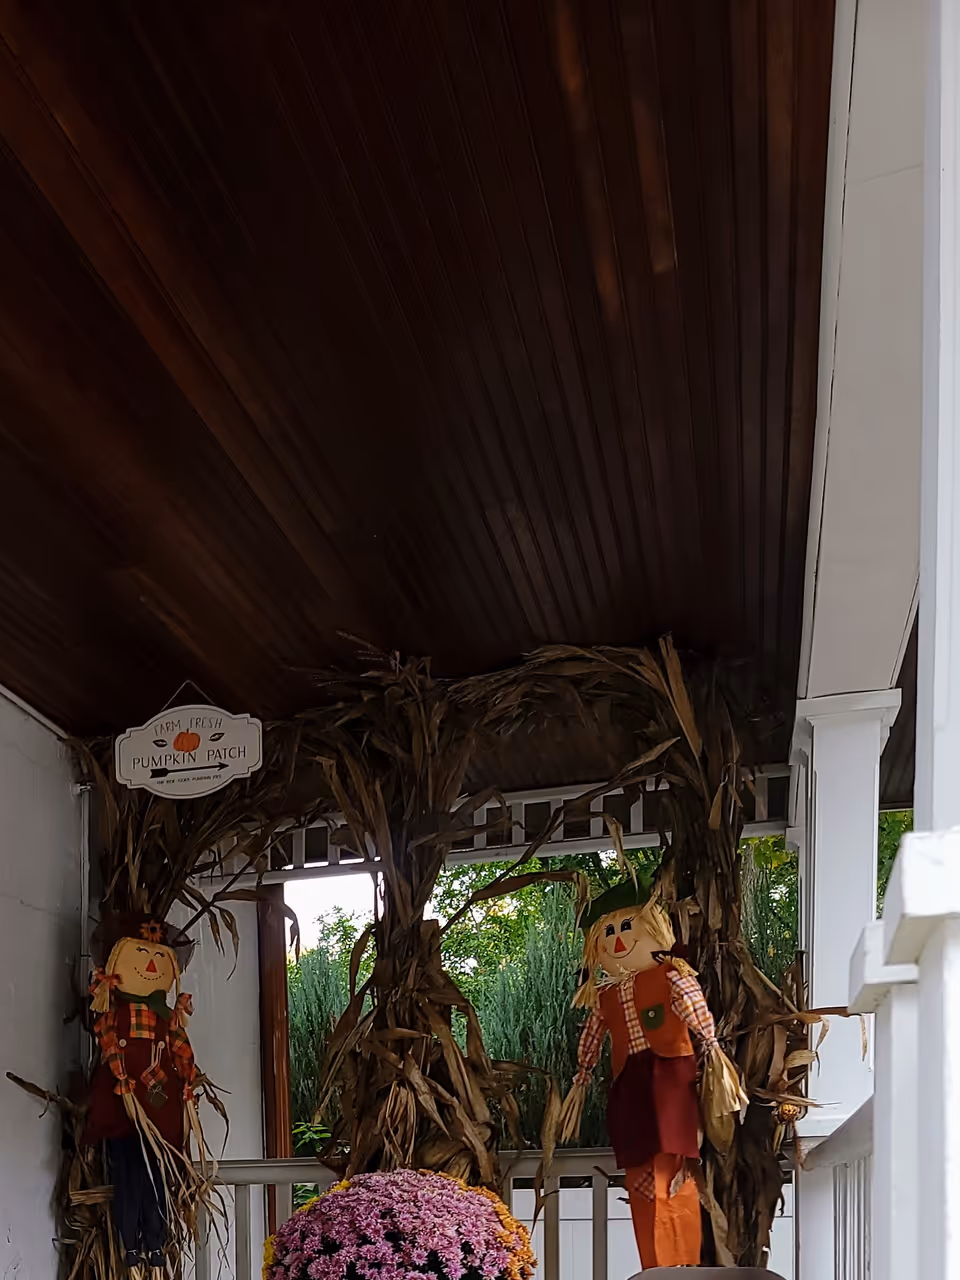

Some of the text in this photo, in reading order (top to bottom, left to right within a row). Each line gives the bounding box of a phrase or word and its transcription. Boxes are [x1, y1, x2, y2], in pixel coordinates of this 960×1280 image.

[154, 717, 223, 736] FARM FRESH
[132, 746, 246, 770] PUMPKIN PATCH
